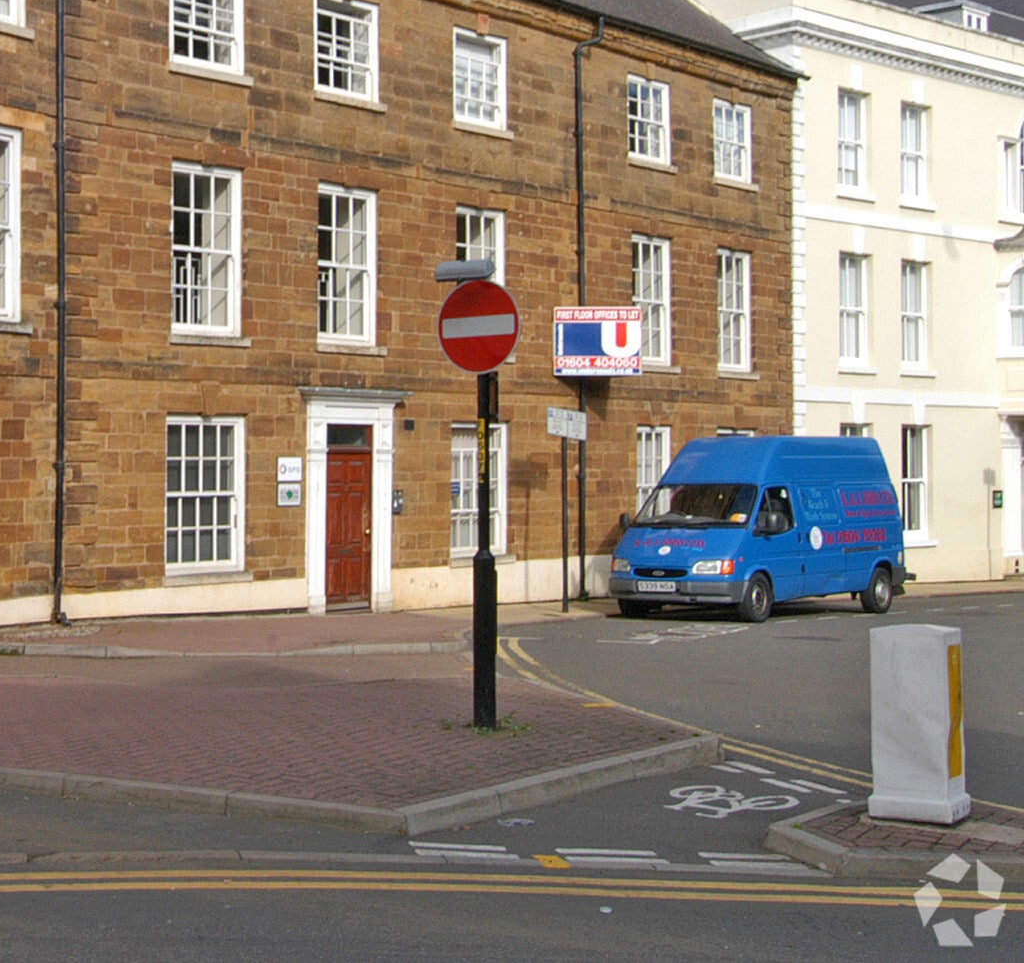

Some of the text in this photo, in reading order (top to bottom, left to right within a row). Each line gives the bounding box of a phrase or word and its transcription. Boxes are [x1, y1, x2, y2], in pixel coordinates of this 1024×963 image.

[574, 310, 593, 319] FLOOR
[619, 310, 627, 319] TO
[628, 310, 639, 319] LET
[557, 357, 590, 367] 01604
